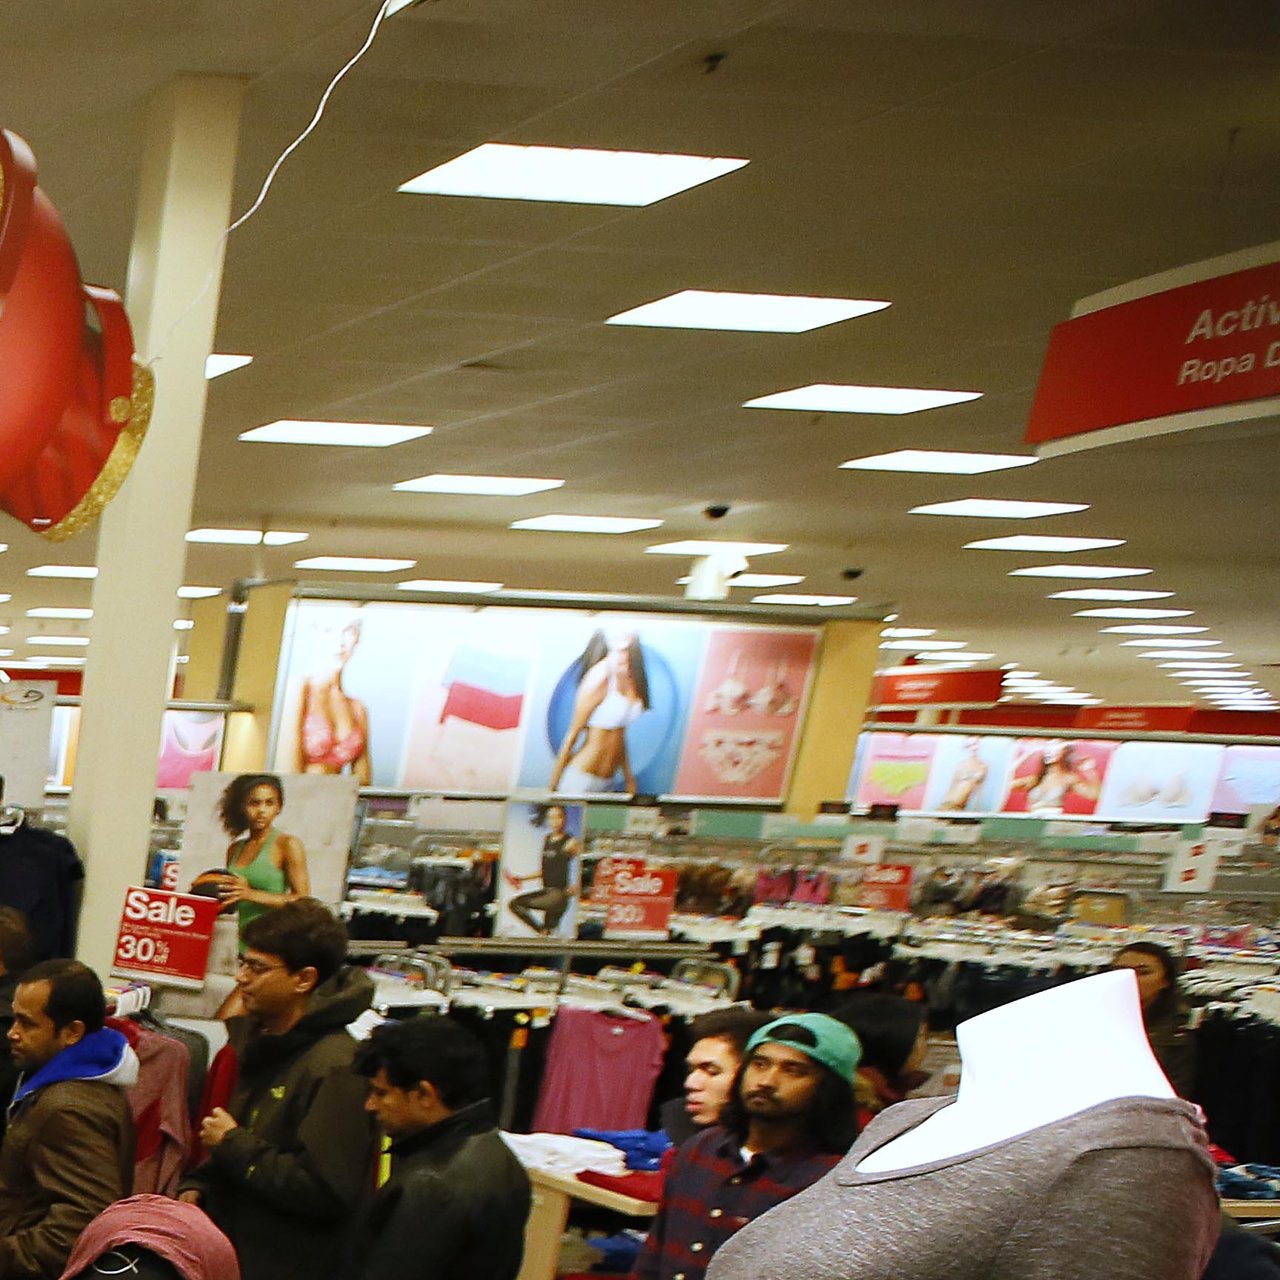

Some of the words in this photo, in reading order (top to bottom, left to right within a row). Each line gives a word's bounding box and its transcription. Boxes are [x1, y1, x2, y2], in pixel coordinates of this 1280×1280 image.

[1177, 351, 1255, 386] Ropa
[615, 871, 664, 895] Sale
[125, 890, 196, 928] Sale
[118, 935, 155, 962] 30
[153, 953, 168, 964] off
